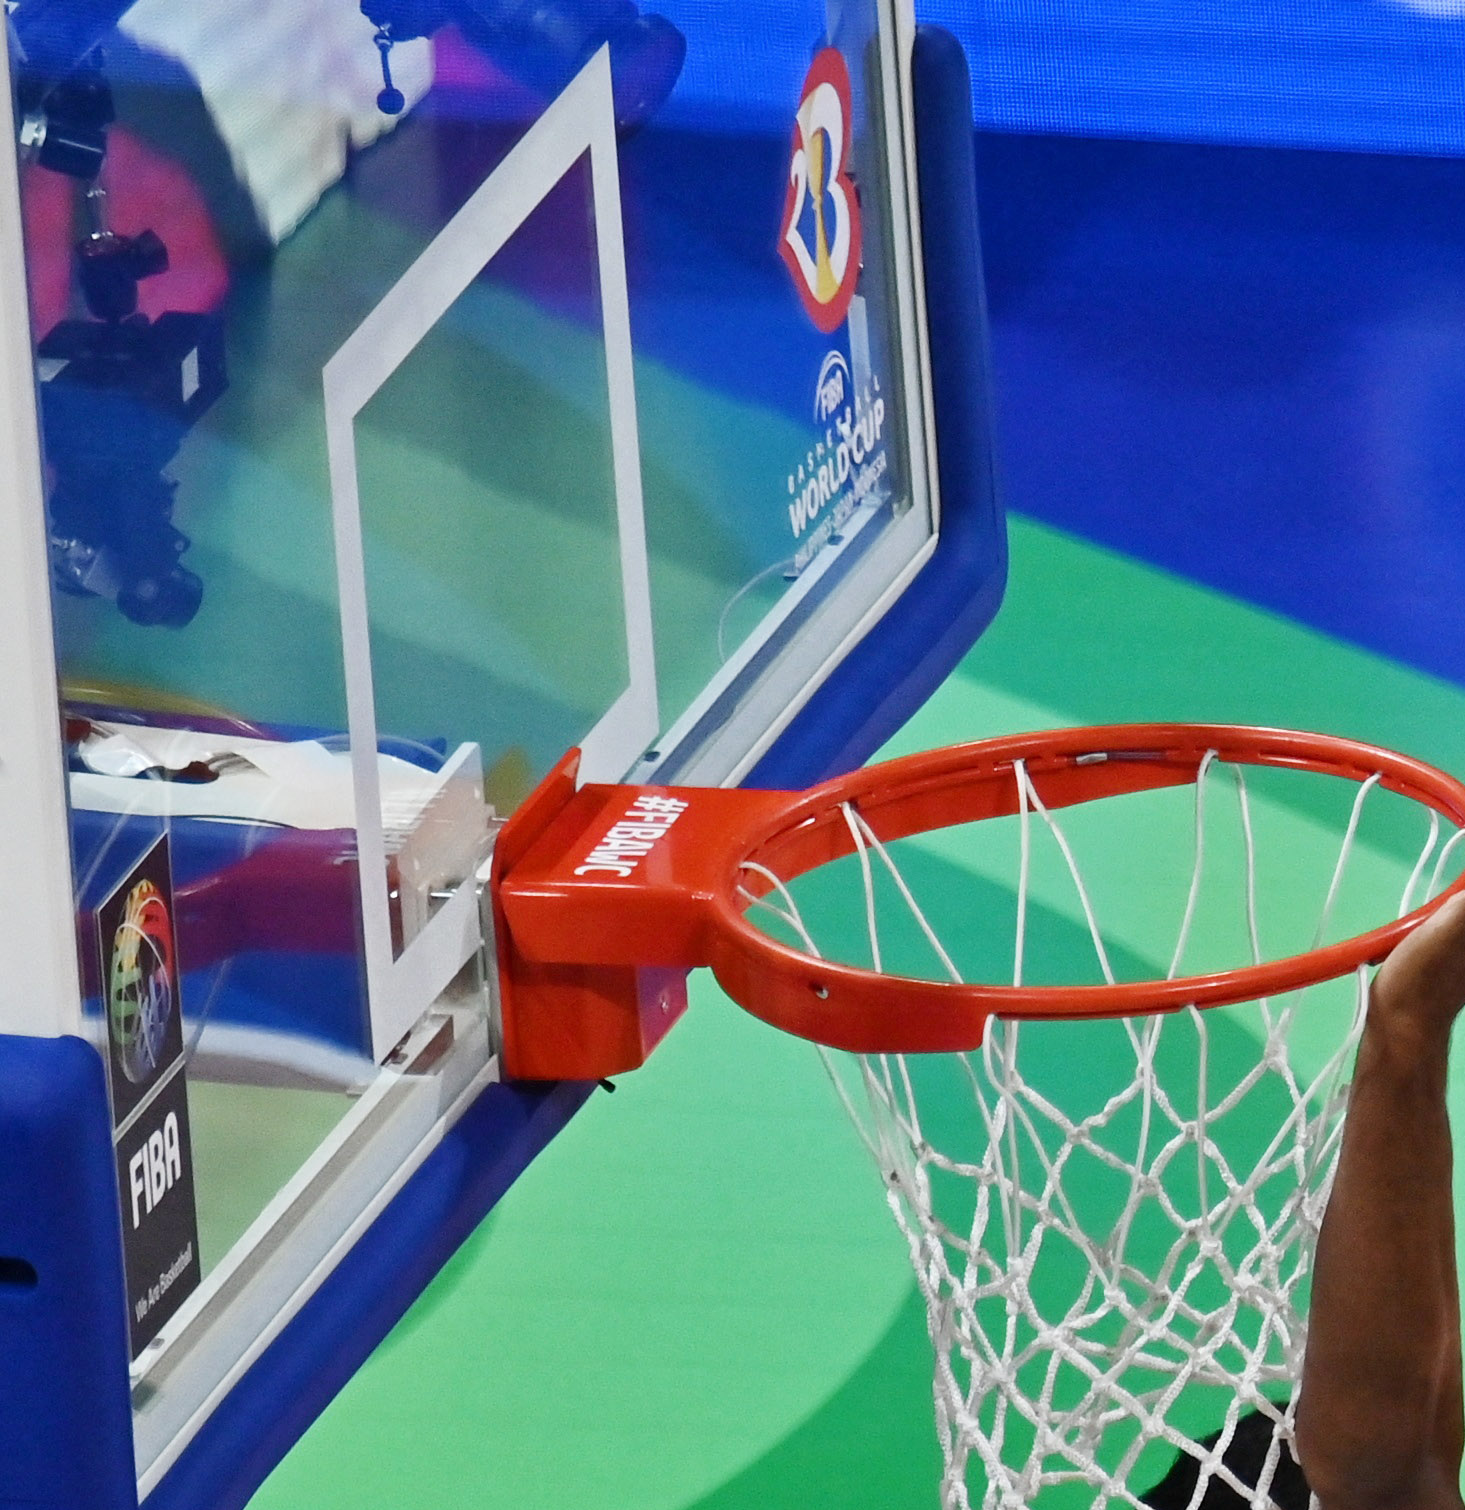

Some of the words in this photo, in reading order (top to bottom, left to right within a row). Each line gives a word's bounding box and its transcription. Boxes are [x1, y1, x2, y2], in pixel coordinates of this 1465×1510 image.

[789, 442, 850, 538] WORLD
[852, 398, 885, 465] CUP
[574, 795, 689, 877] #FIBAWC
[129, 1111, 182, 1230] FIBA
